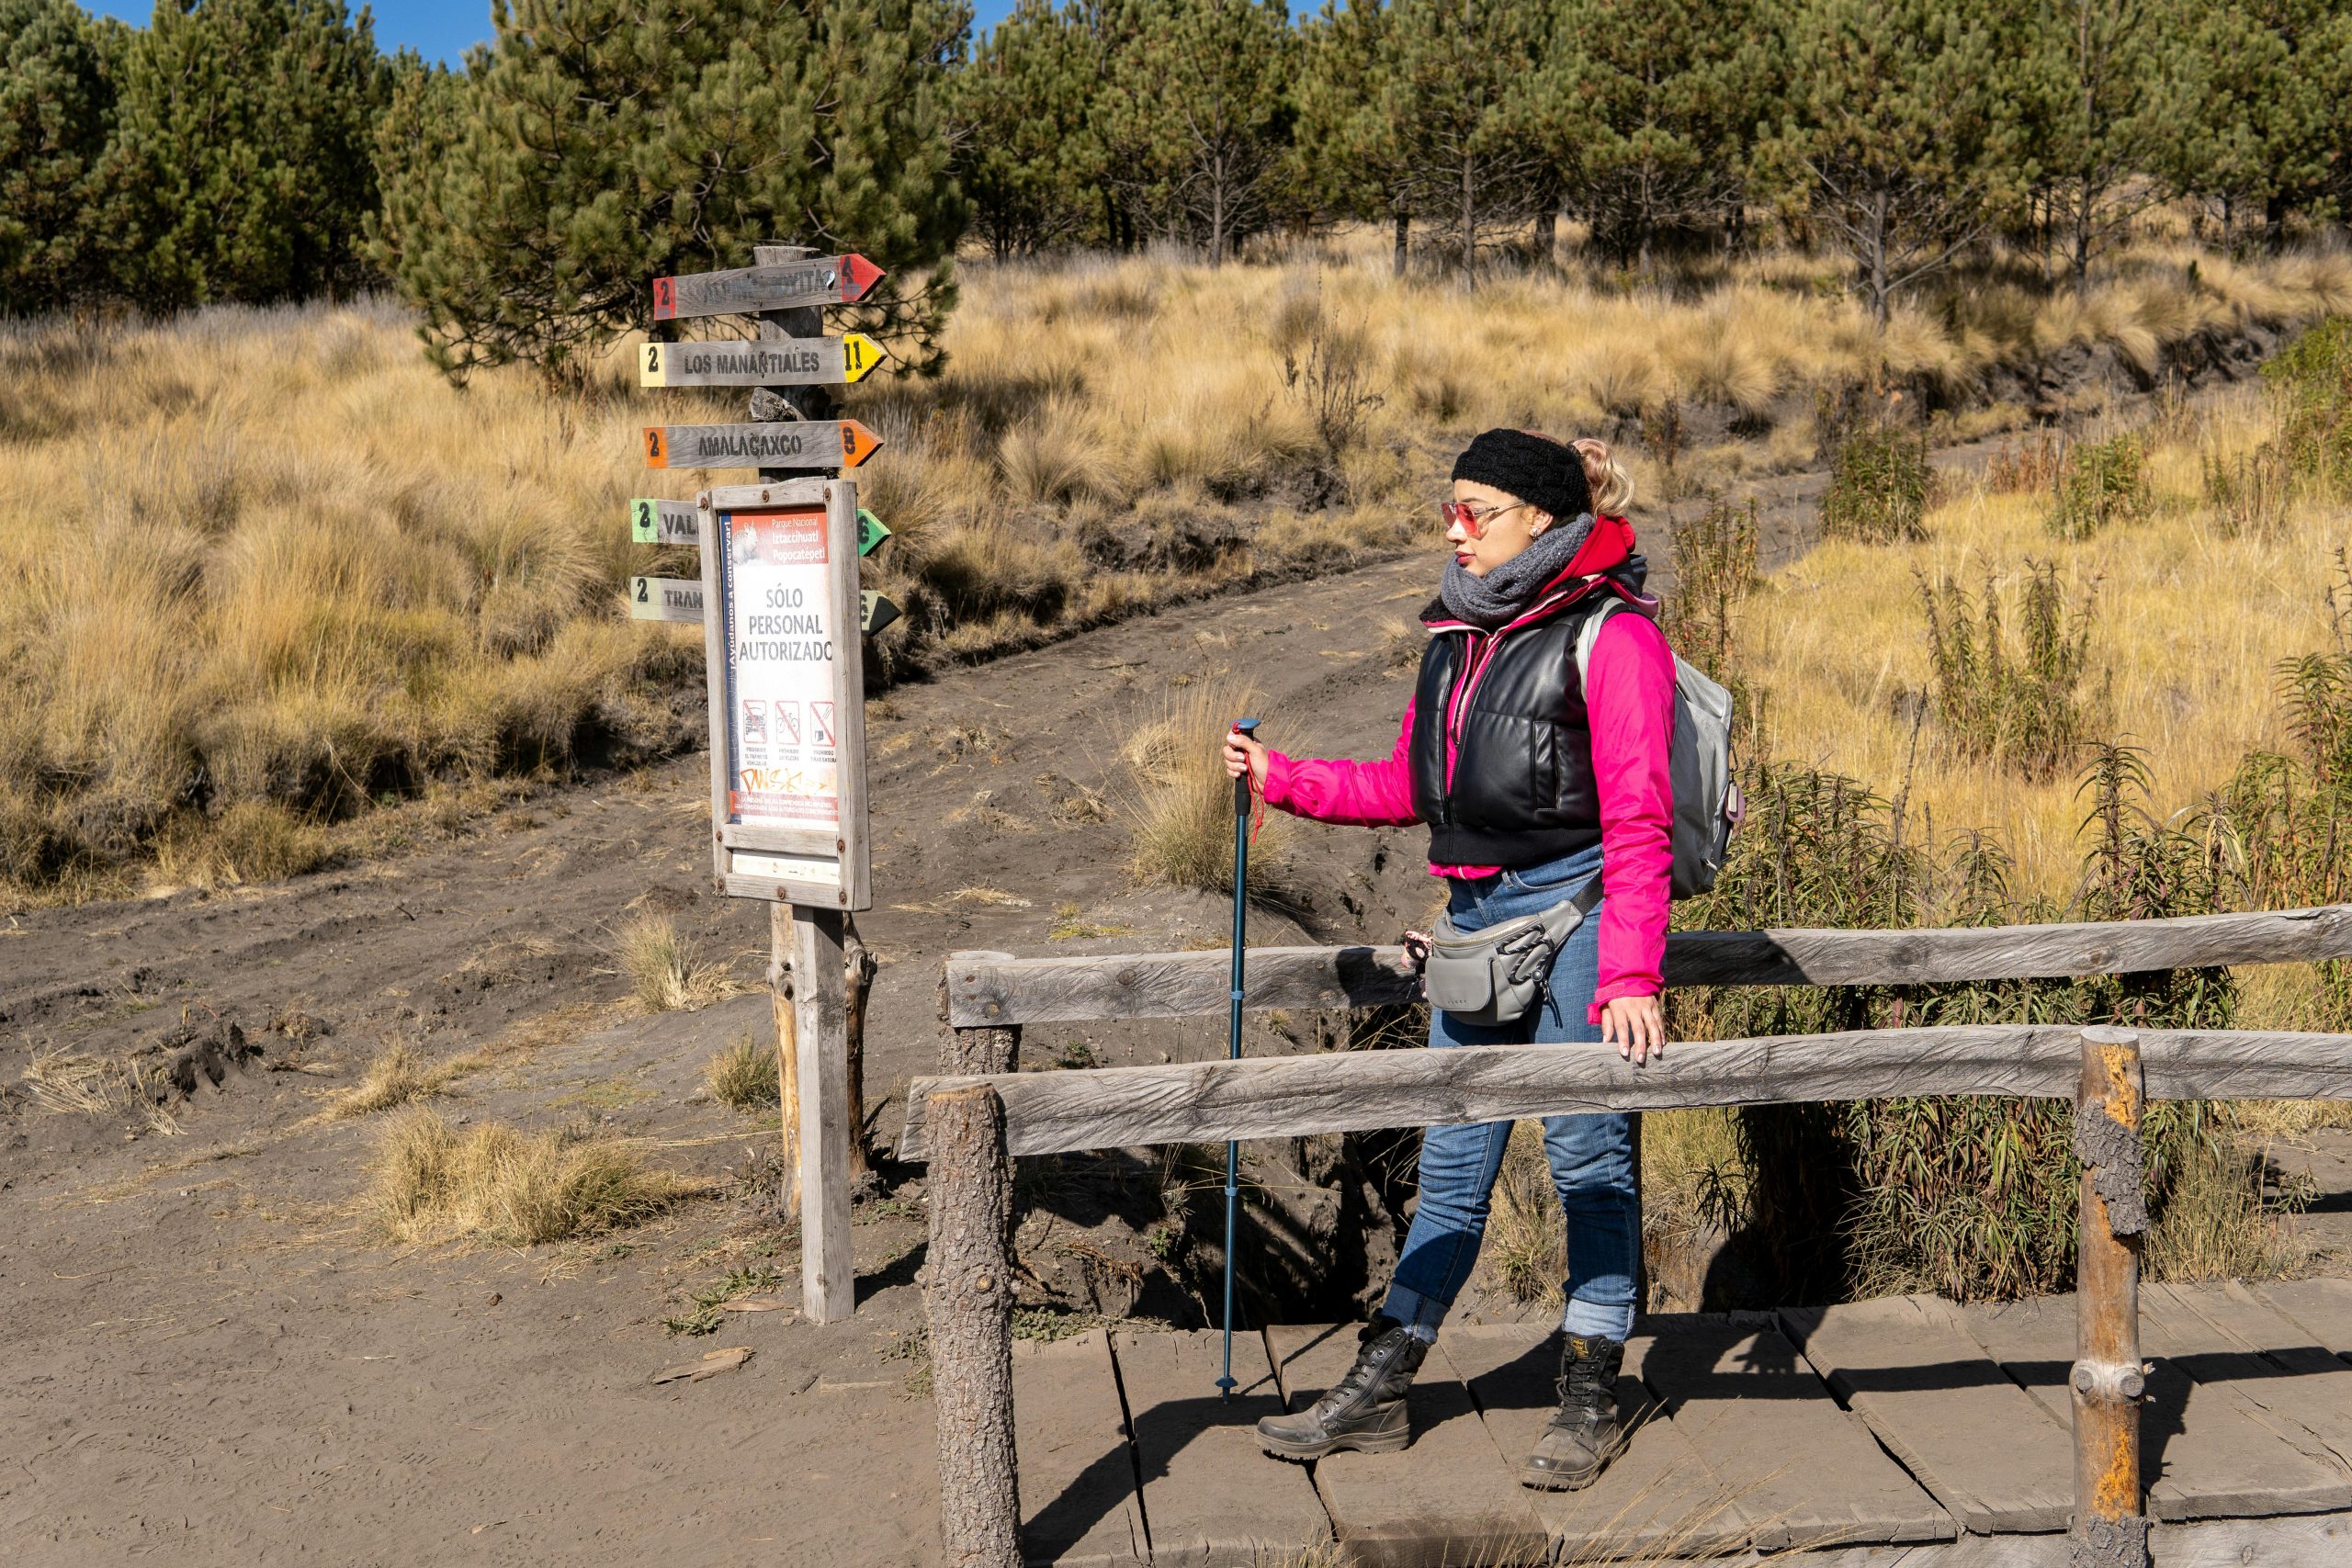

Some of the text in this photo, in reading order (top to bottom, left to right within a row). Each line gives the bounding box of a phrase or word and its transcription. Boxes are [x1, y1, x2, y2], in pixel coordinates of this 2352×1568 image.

[661, 280, 670, 305] 2
[648, 341, 862, 374] 2 LOS MANANTIALES 11
[649, 432, 660, 457] 2
[639, 502, 650, 528] 2
[663, 513, 699, 535] VAL
[772, 516, 818, 529] Parque Nacional
[724, 522, 734, 589] conservar!
[774, 547, 825, 561] Popocatépetl
[638, 577, 649, 603] 2
[728, 591, 734, 599] a
[766, 582, 803, 608] SÓLO
[749, 615, 823, 635] PERSONAL
